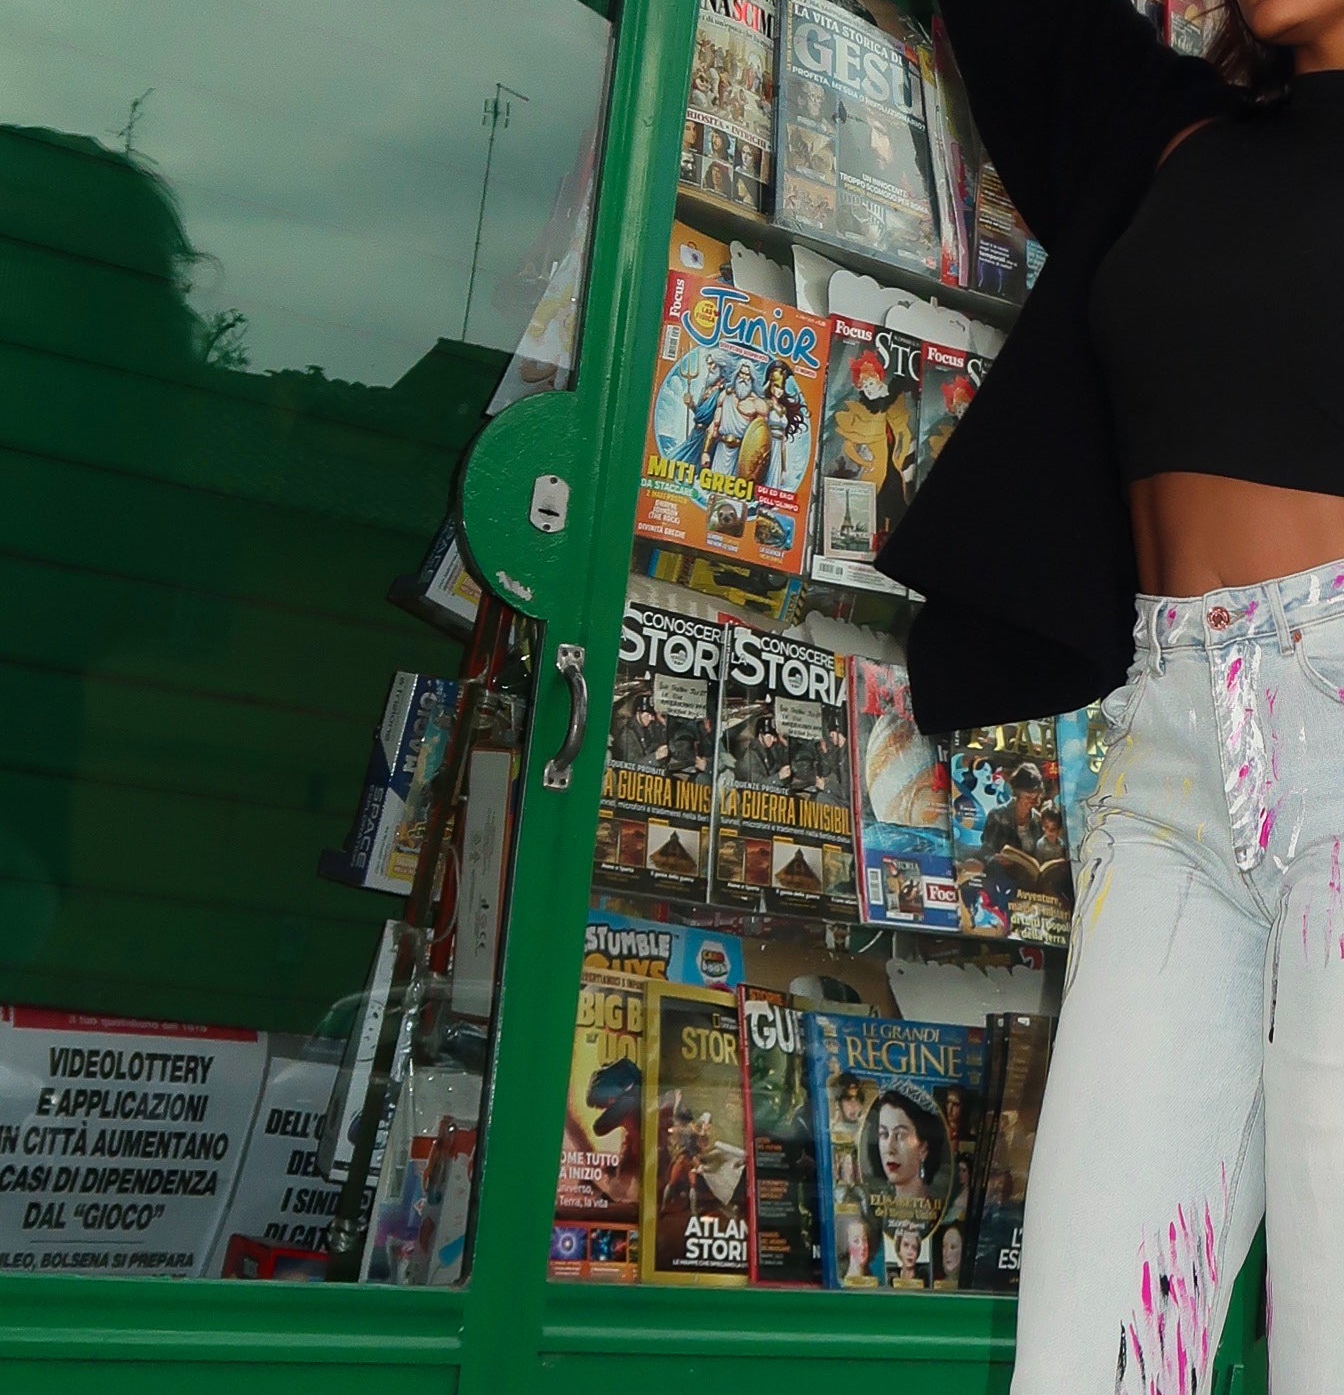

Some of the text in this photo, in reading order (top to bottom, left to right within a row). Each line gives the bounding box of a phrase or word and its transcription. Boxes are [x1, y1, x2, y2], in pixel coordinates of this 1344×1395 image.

[794, 4, 903, 67] LA VITA STORICA DI
[669, 278, 685, 319] Focus
[835, 319, 873, 342] Focus
[927, 346, 965, 368] Focus
[640, 478, 695, 498] DA STACCARE
[647, 456, 754, 501] MITI GRECI
[643, 611, 721, 643] CONOSCER
[730, 627, 847, 707] STORIA
[761, 636, 834, 670] CONOSCERE
[603, 767, 711, 814] A GUERRA INVIS
[354, 783, 386, 868] SPACE
[719, 787, 852, 836] LA GUERRA INVISIBIL
[584, 925, 672, 958] STUMBLE
[575, 989, 643, 1033] BIG B
[681, 1025, 739, 1067] STOR
[862, 1022, 941, 1043] LE GRANDI
[49, 1046, 214, 1084] VIDEOLOTTERY
[844, 1035, 963, 1078] REGINE
[35, 1087, 209, 1123] E APPLICAZIONI
[22, 1121, 88, 1157] CITTÀ
[90, 1129, 229, 1161] AUMENTANO
[569, 1167, 602, 1180] INIZIO
[586, 1153, 619, 1166] TUTTO
[0, 1164, 219, 1197] CASI DI DIPENDENZA
[22, 1200, 66, 1230] DAL
[584, 1197, 592, 1208] la
[684, 1215, 749, 1240] ATLAN
[40, 1252, 110, 1269] BOLSENA
[111, 1253, 127, 1269] SI
[127, 1253, 195, 1269] PREPARA
[685, 1237, 748, 1262] STORI
[998, 1249, 1020, 1271] ES
